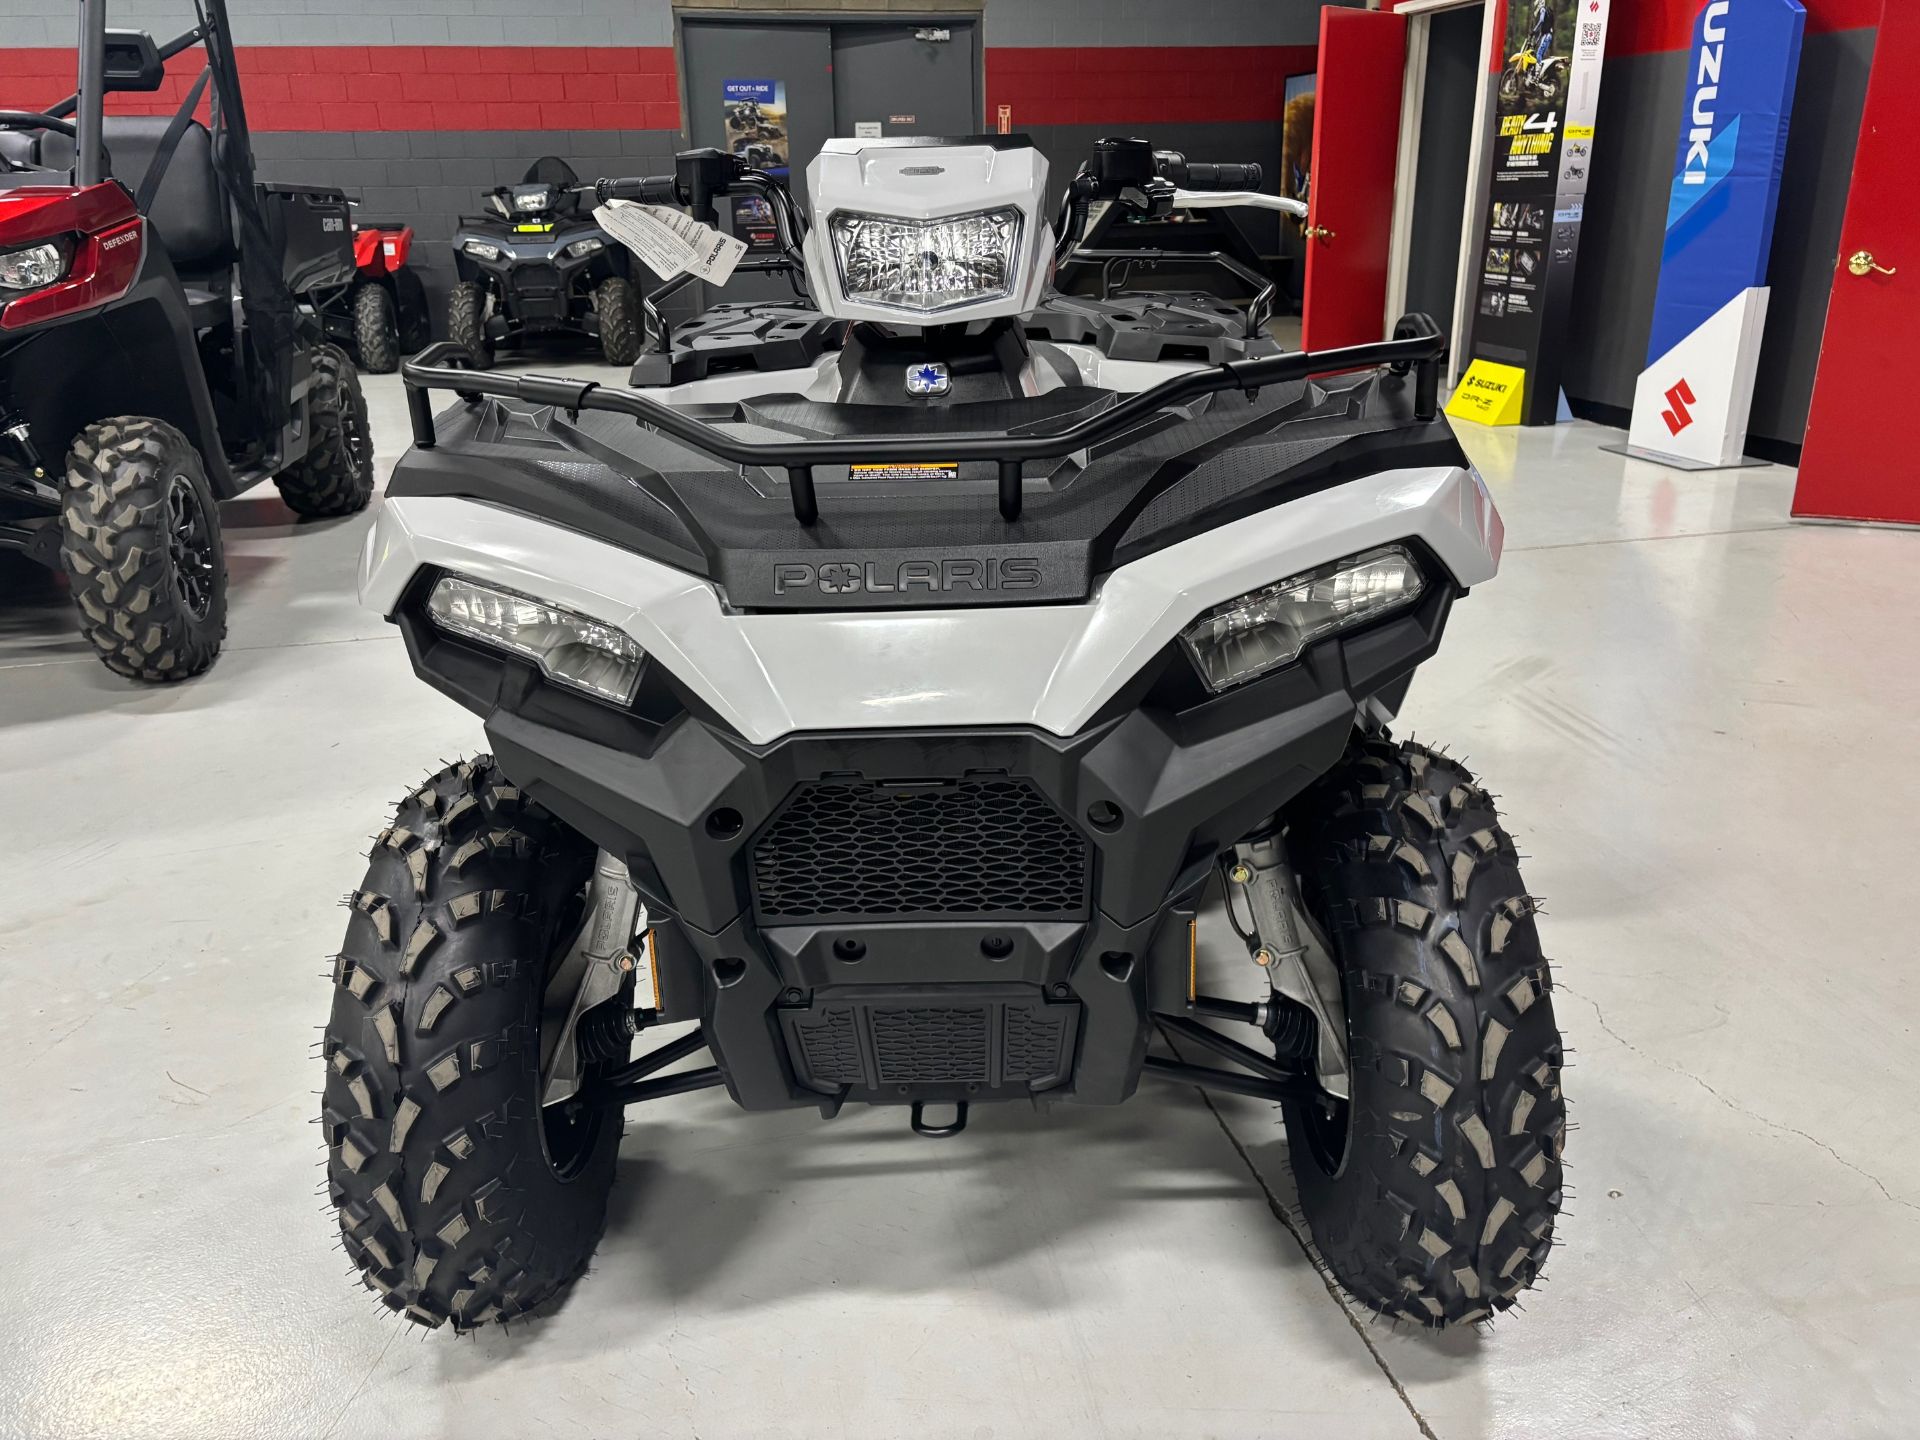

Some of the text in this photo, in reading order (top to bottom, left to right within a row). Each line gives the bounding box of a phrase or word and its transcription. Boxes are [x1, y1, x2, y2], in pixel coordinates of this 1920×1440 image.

[1683, 0, 1729, 185] UZUKI
[1500, 111, 1558, 136] READY 4
[1509, 133, 1555, 155] ANYTHING
[102, 230, 138, 250] DEFENDER
[706, 237, 727, 266] POLARIS
[1474, 378, 1508, 393] SUZUKI
[774, 557, 1043, 596] POLARIS
